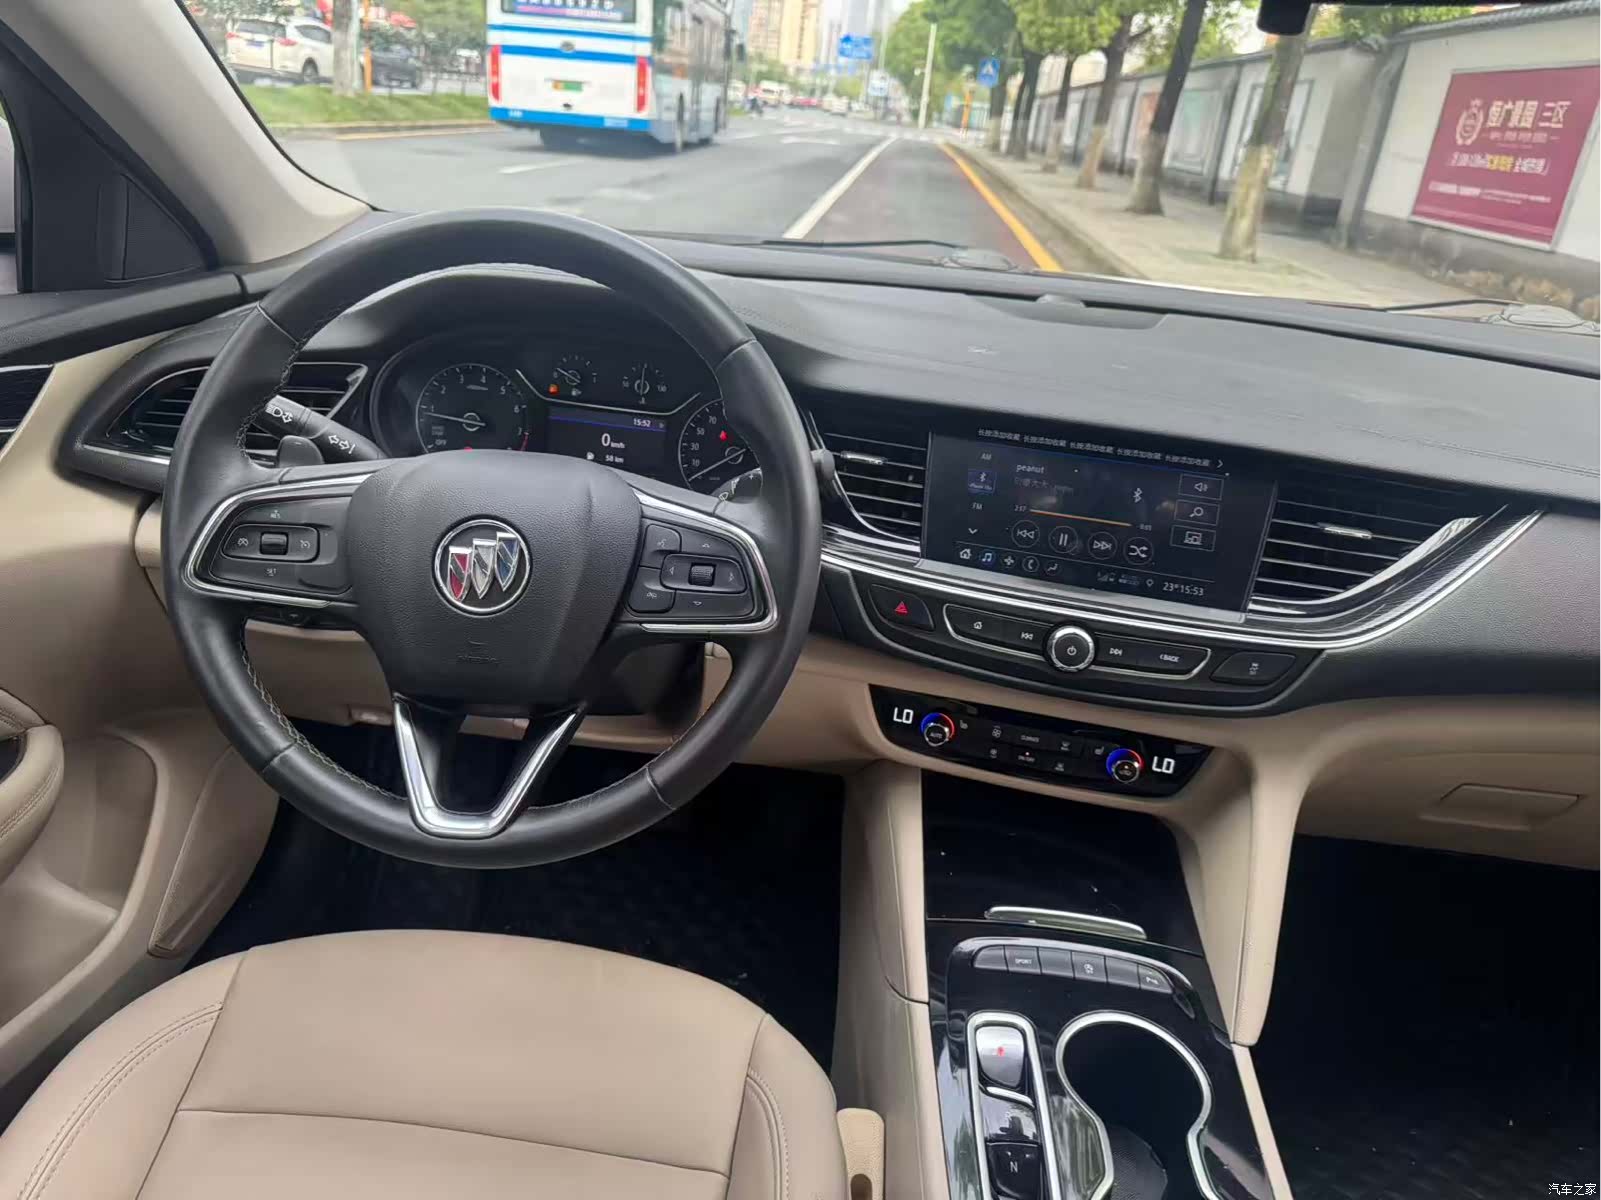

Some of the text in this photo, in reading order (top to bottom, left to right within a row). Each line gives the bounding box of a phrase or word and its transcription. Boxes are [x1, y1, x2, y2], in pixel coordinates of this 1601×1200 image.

[1538, 100, 1571, 129] 三区
[440, 385, 446, 395] 2
[633, 418, 651, 428] 15:52
[708, 416, 717, 425] 70
[601, 432, 611, 447] 0
[691, 442, 700, 451] 30
[1016, 464, 1045, 474] peanut
[1179, 584, 1205, 597] 15:53
[893, 707, 914, 724] LO
[1151, 756, 1175, 775] LO
[1009, 1161, 1018, 1173] N
